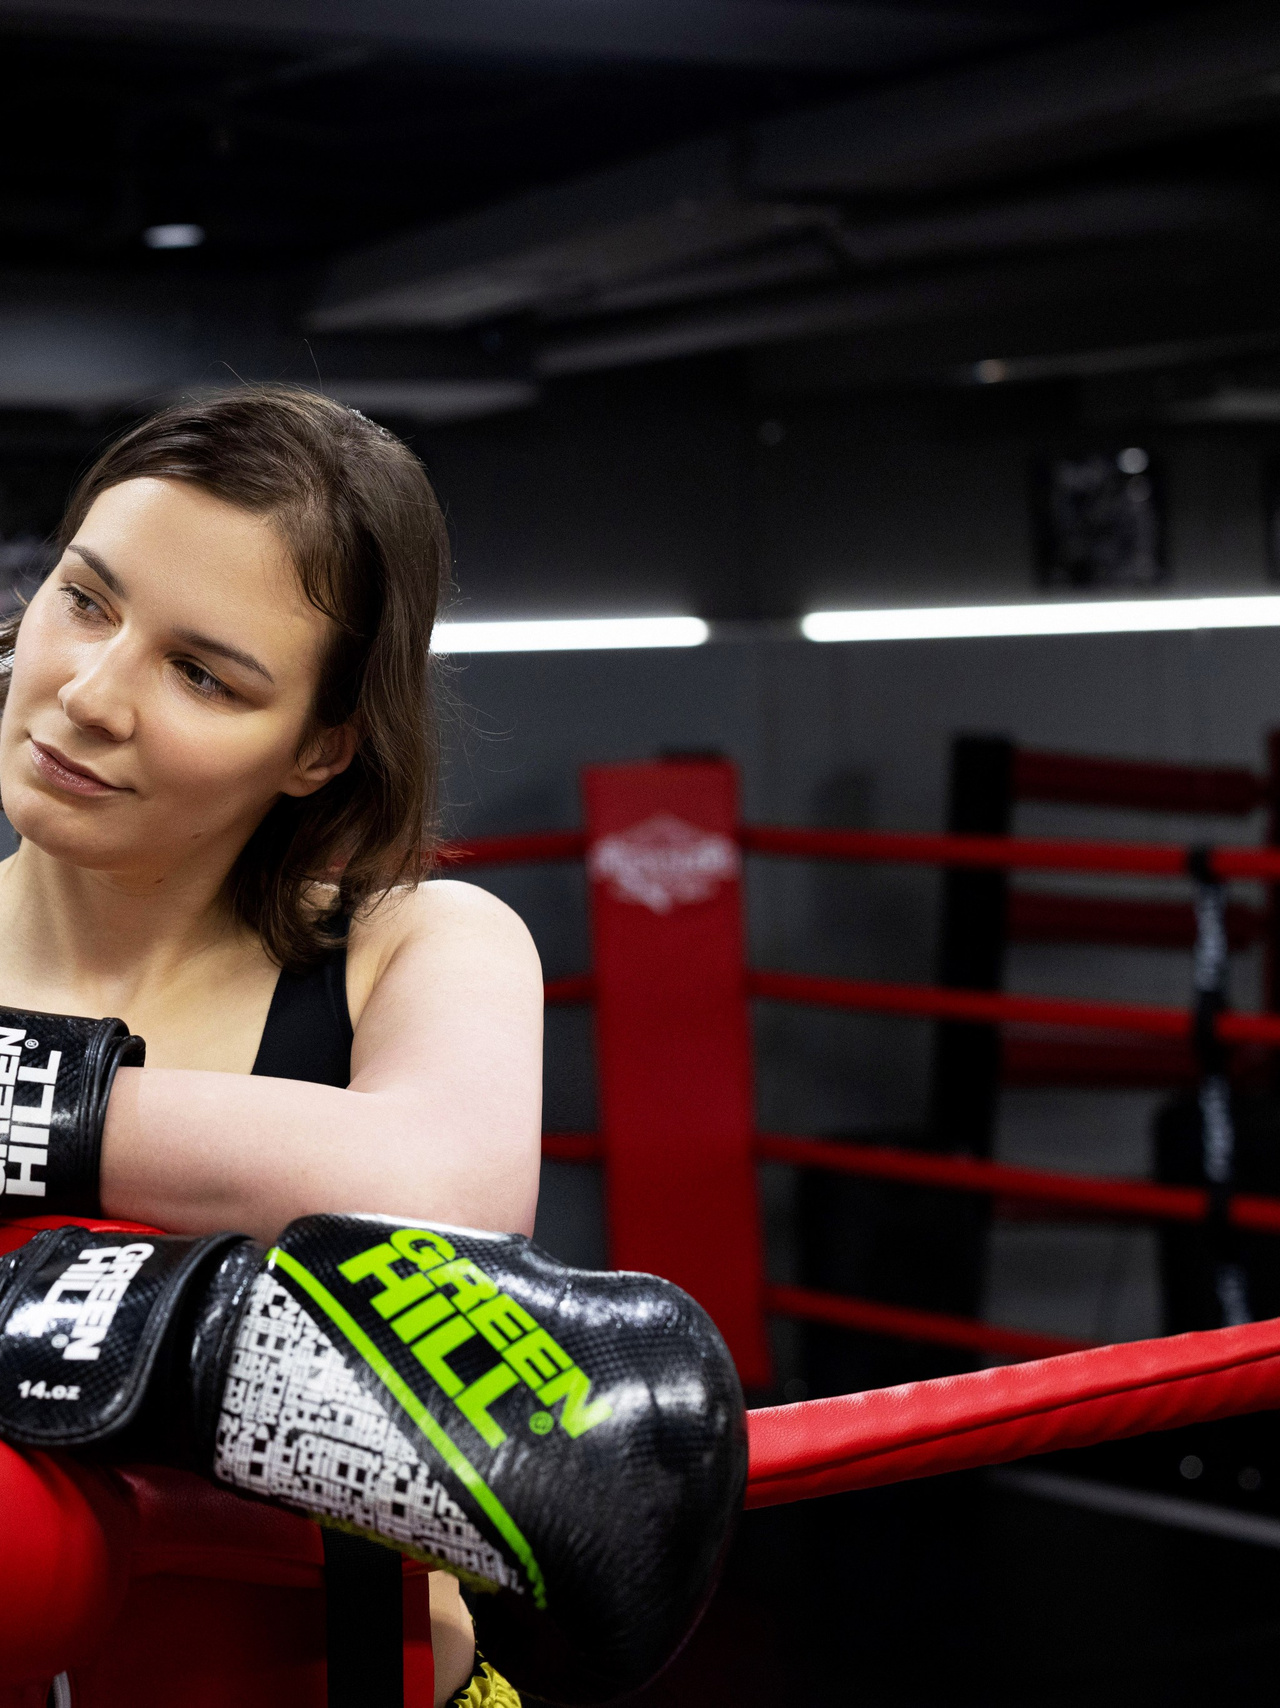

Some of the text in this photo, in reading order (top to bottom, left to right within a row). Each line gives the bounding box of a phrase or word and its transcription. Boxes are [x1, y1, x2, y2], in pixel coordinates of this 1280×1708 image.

[5, 1050, 62, 1197] HILL
[28, 1246, 122, 1338] HILL
[62, 1243, 155, 1360] GREEN
[337, 1242, 520, 1449] HILL
[390, 1229, 613, 1439] GREEN
[18, 1379, 81, 1401] 14.oz
